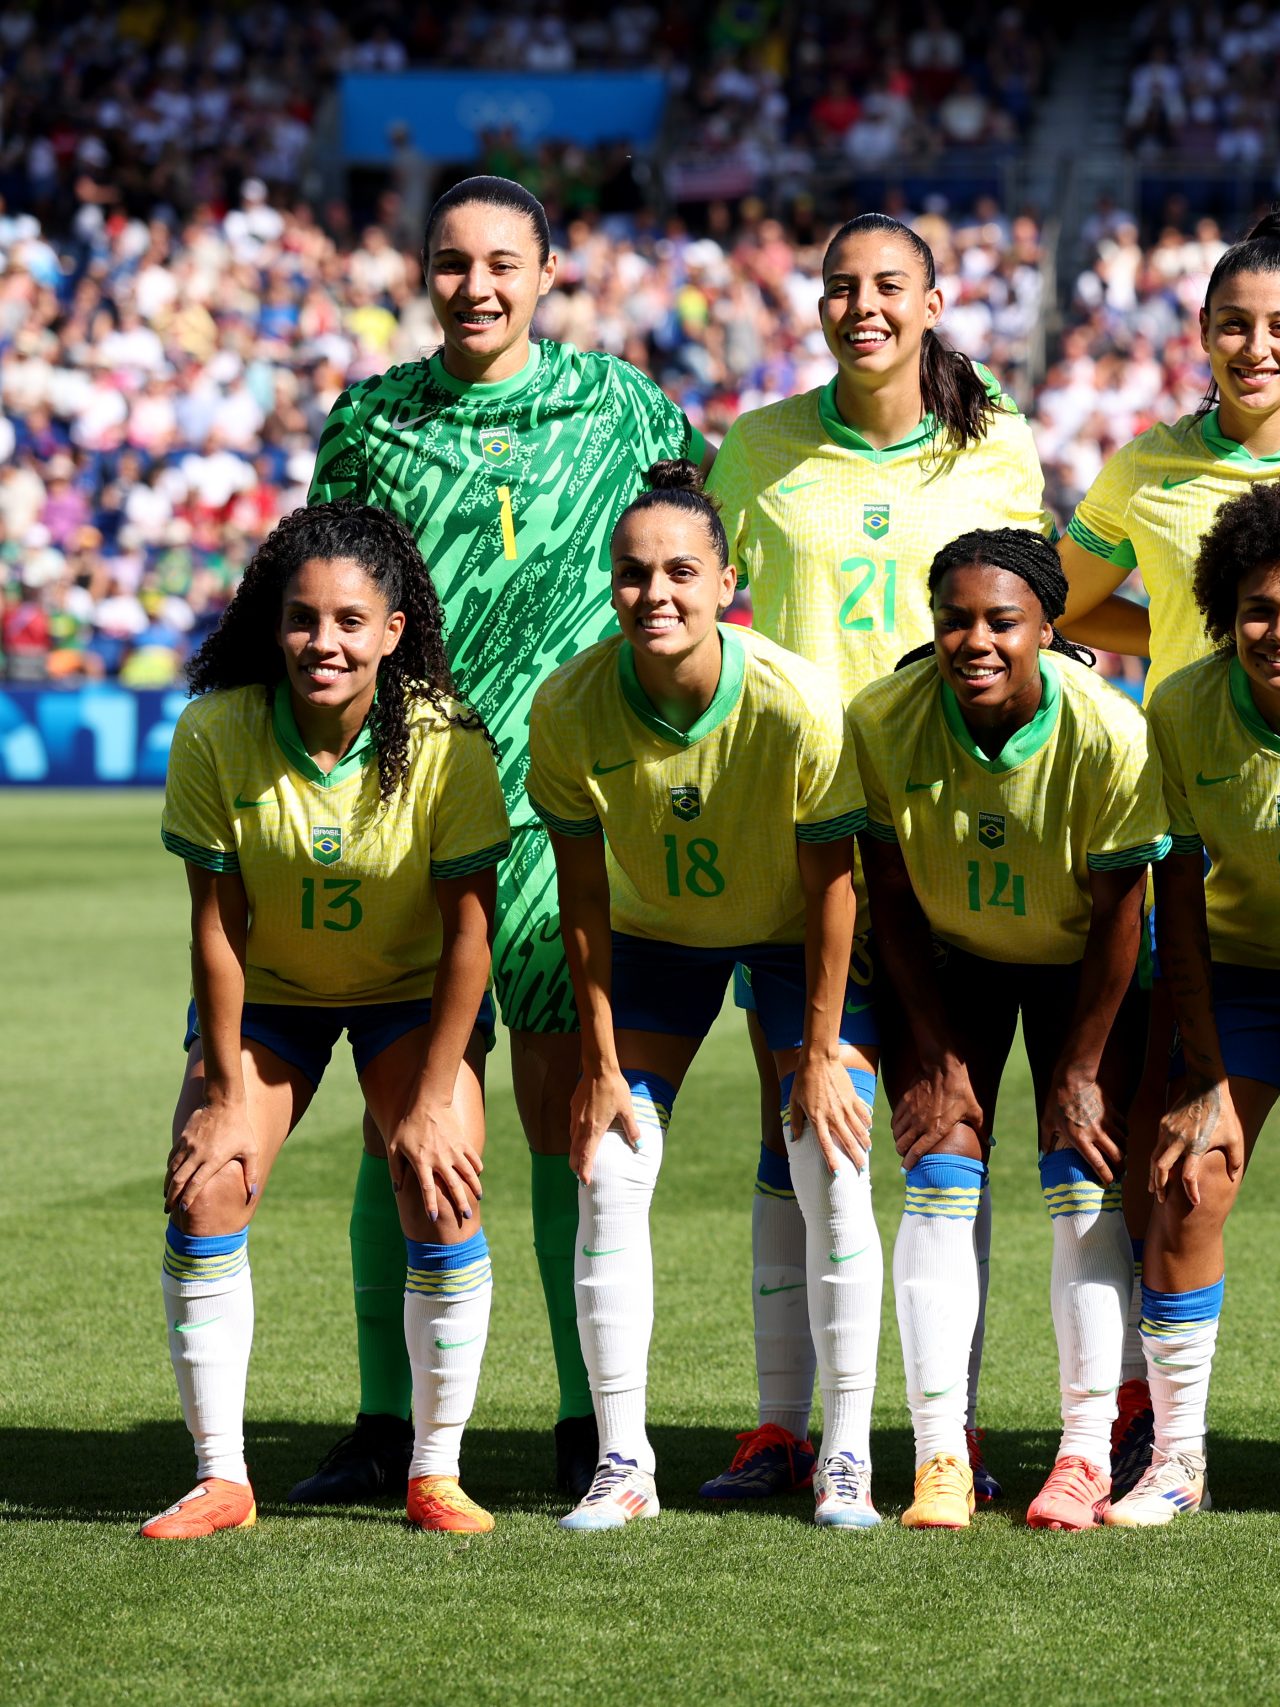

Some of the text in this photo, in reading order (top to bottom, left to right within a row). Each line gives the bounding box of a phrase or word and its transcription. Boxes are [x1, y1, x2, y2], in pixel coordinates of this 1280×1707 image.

[481, 430, 508, 439] BRASIL
[497, 485, 517, 560] 1
[839, 557, 896, 632] 21
[313, 827, 341, 837] BRASIL
[980, 814, 1005, 824] BRASIL
[664, 834, 725, 898] 18
[968, 860, 1026, 916] 14
[302, 877, 363, 932] 13
